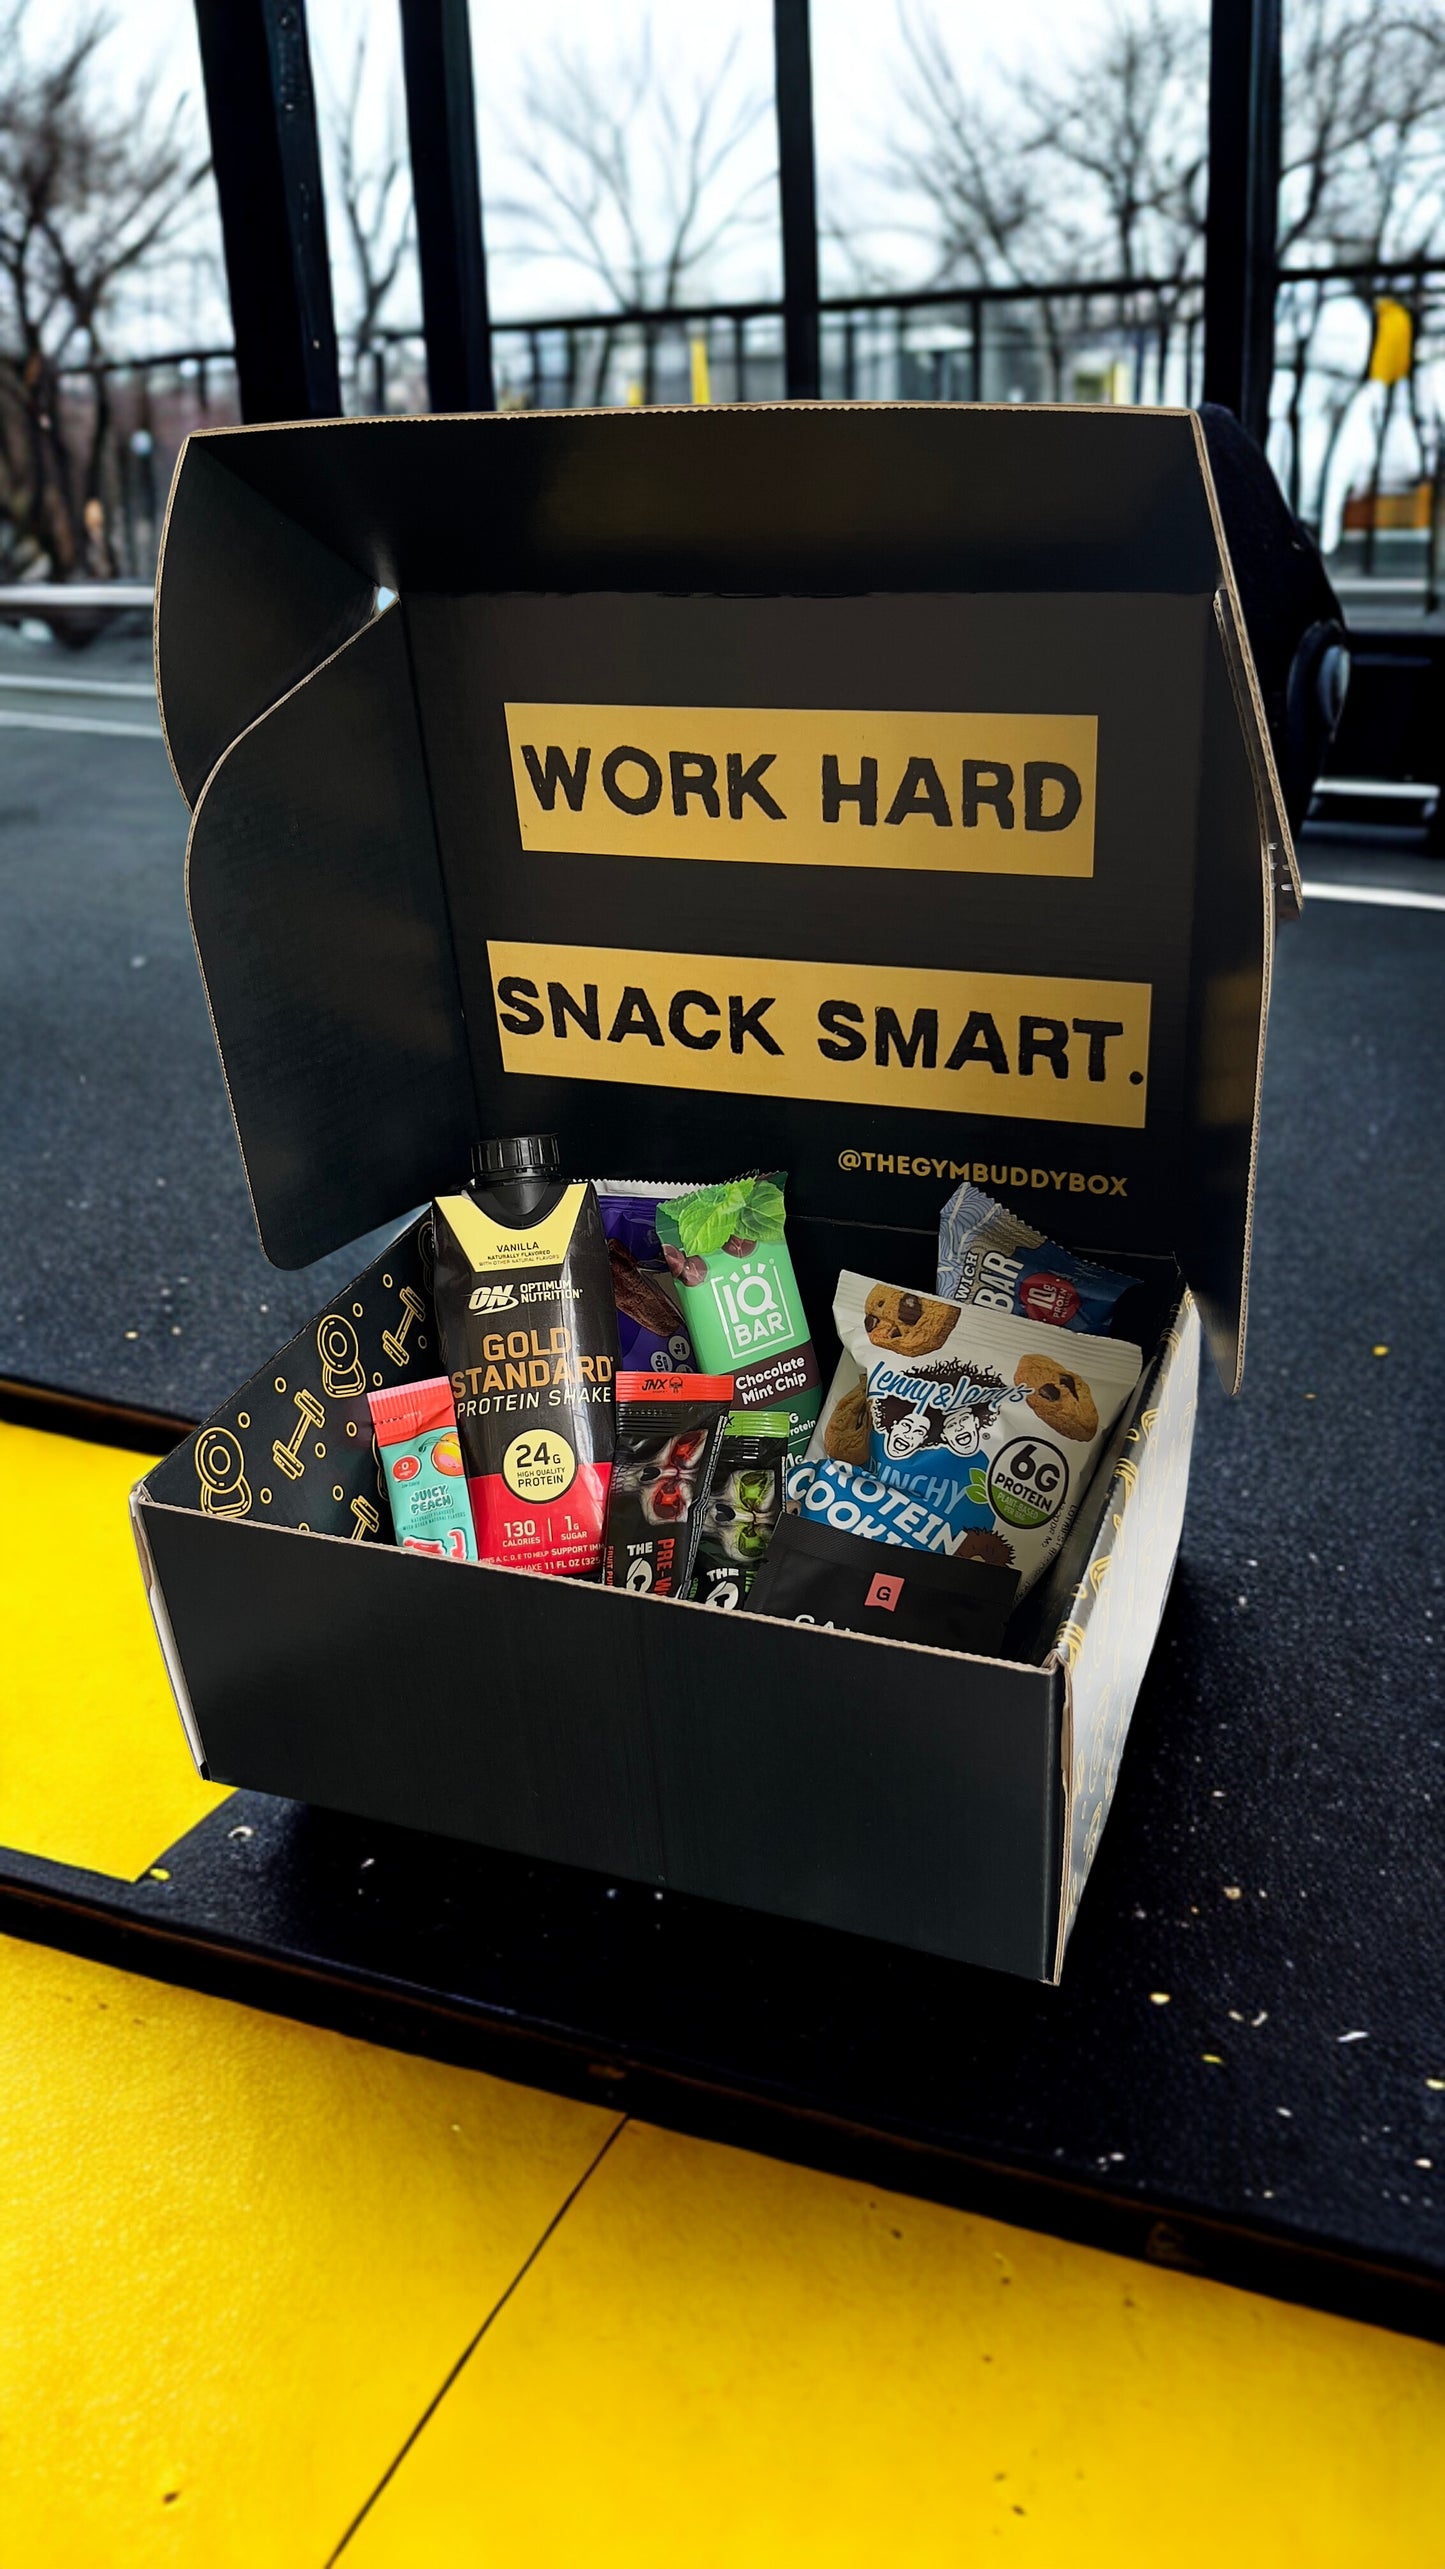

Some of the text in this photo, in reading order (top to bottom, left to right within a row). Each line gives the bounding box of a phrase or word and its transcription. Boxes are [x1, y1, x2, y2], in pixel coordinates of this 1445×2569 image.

[521, 745, 1082, 832] WORK HARD
[497, 976, 1144, 1085] SNACK SMART.
[838, 1148, 1128, 1198] @THEGYMBUDDYBOX
[487, 1249, 551, 1261] NATURALLY FLAVORED
[496, 1241, 540, 1253] VANILLA
[520, 1280, 572, 1293] OPTIMUM
[973, 1250, 1024, 1314] BAR
[468, 1284, 515, 1311] ON
[521, 1289, 580, 1304] NUTRITION
[722, 1275, 779, 1324] IQ
[733, 1311, 786, 1347] BAR
[482, 1327, 572, 1362] GOLD
[451, 1355, 613, 1399] STANDARD
[735, 1356, 806, 1391] Chocolate
[641, 1379, 668, 1391] JNX
[741, 1372, 808, 1406] Mint Chip
[457, 1386, 612, 1419] PROTEIN SHAKE
[789, 1418, 817, 1436] rotein
[516, 1467, 566, 1478] HIGH QUALITY
[1010, 1443, 1061, 1493] 6G
[517, 1474, 564, 1488] PROTEIN
[410, 1484, 449, 1503] JUICY
[994, 1472, 1053, 1513] PROTEIN
[410, 1494, 453, 1515] PEACH
[824, 1459, 969, 1556] ROTEIN
[996, 1491, 1040, 1521] PLANT-BASED
[1003, 1505, 1027, 1522] PER BAG
[503, 1519, 536, 1538] 130
[561, 1531, 588, 1541] SUGAR
[502, 1536, 541, 1548] CALORIES
[523, 1552, 533, 1560] TO
[532, 1550, 549, 1559] HELP
[551, 1545, 589, 1556] SUPPORT
[626, 1541, 653, 1557] THE
[544, 1562, 555, 1570] 11
[556, 1560, 567, 1568] FL
[569, 1559, 580, 1568] OZ
[606, 1545, 614, 1568] FRUIT
[653, 1538, 676, 1597] PRE-W
[706, 1567, 740, 1582] THE
[876, 1586, 893, 1602] G
